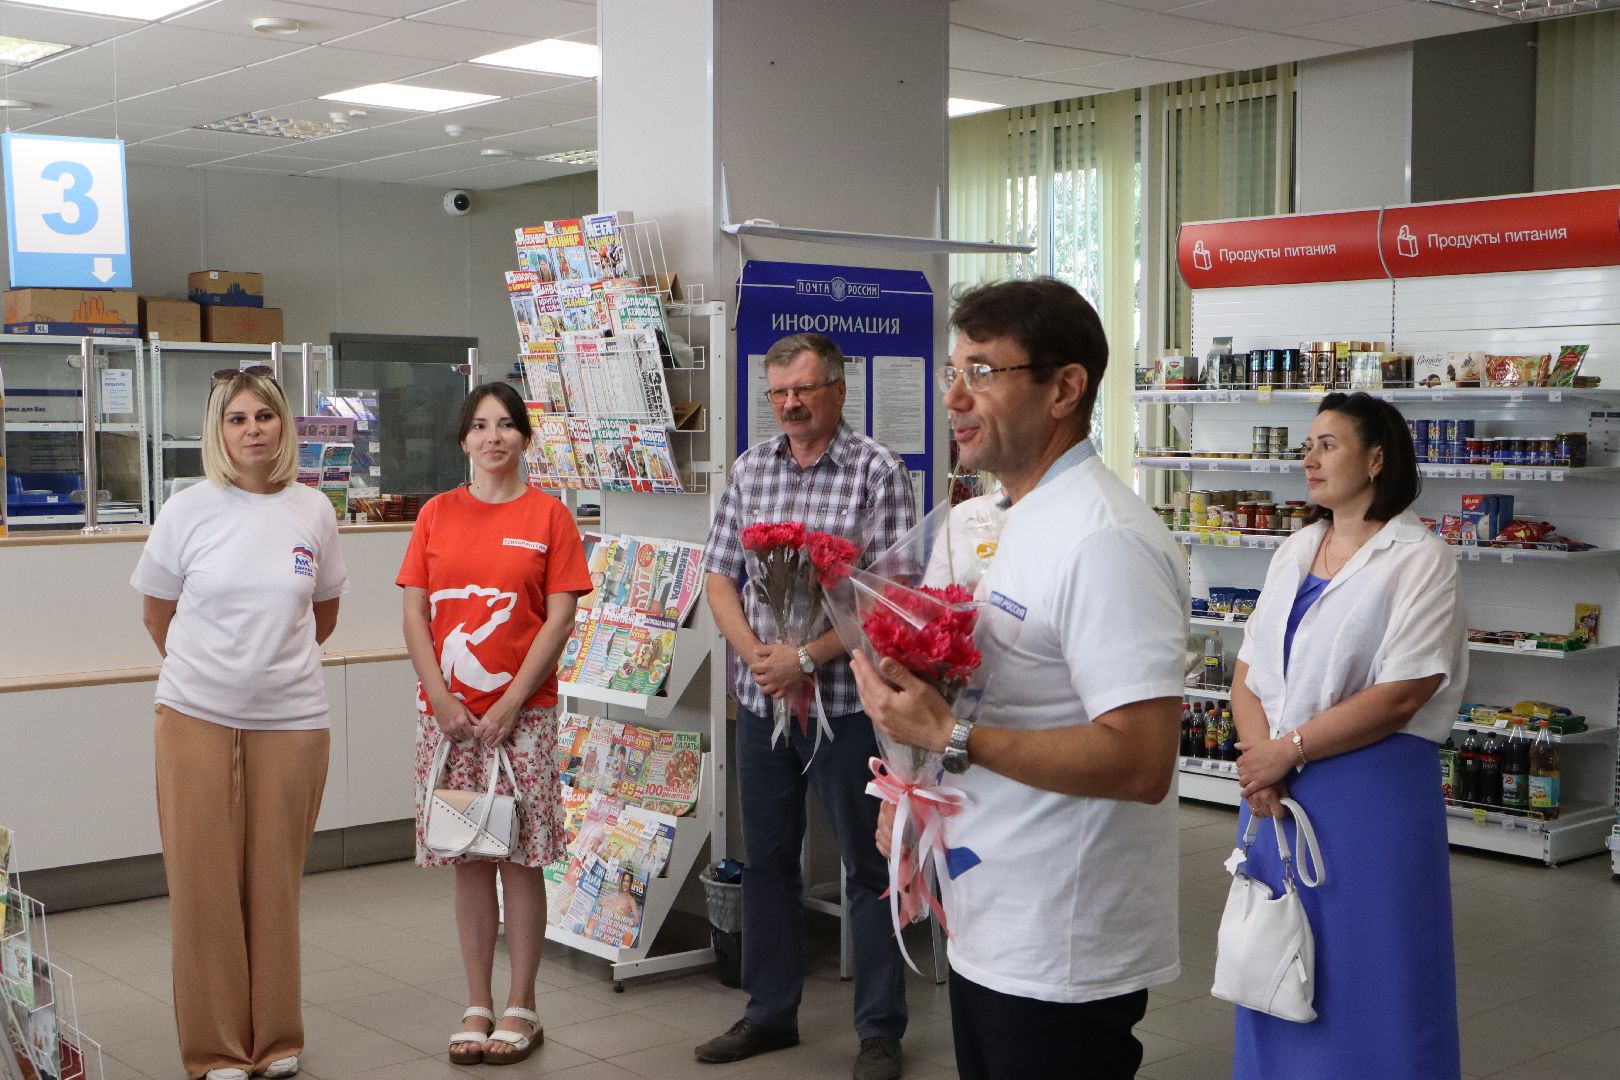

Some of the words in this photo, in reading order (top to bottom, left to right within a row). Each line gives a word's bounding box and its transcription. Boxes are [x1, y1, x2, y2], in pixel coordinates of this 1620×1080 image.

[40, 160, 99, 236] 3
[1427, 232, 1500, 251] Продукты
[1503, 226, 1567, 244] питания
[1218, 247, 1281, 263] Продукты
[1284, 243, 1337, 258] питания
[798, 281, 830, 294] ПОЧТА
[847, 286, 878, 296] РОССИИ
[771, 313, 900, 335] ИНФОРМАЦИЯ
[670, 547, 690, 600] ПЕНСИОНЕРА
[674, 742, 699, 751] САЛАТЫ
[675, 733, 698, 743] ЛЕТНИЕ
[621, 781, 636, 794] 95
[645, 783, 663, 797] 100
